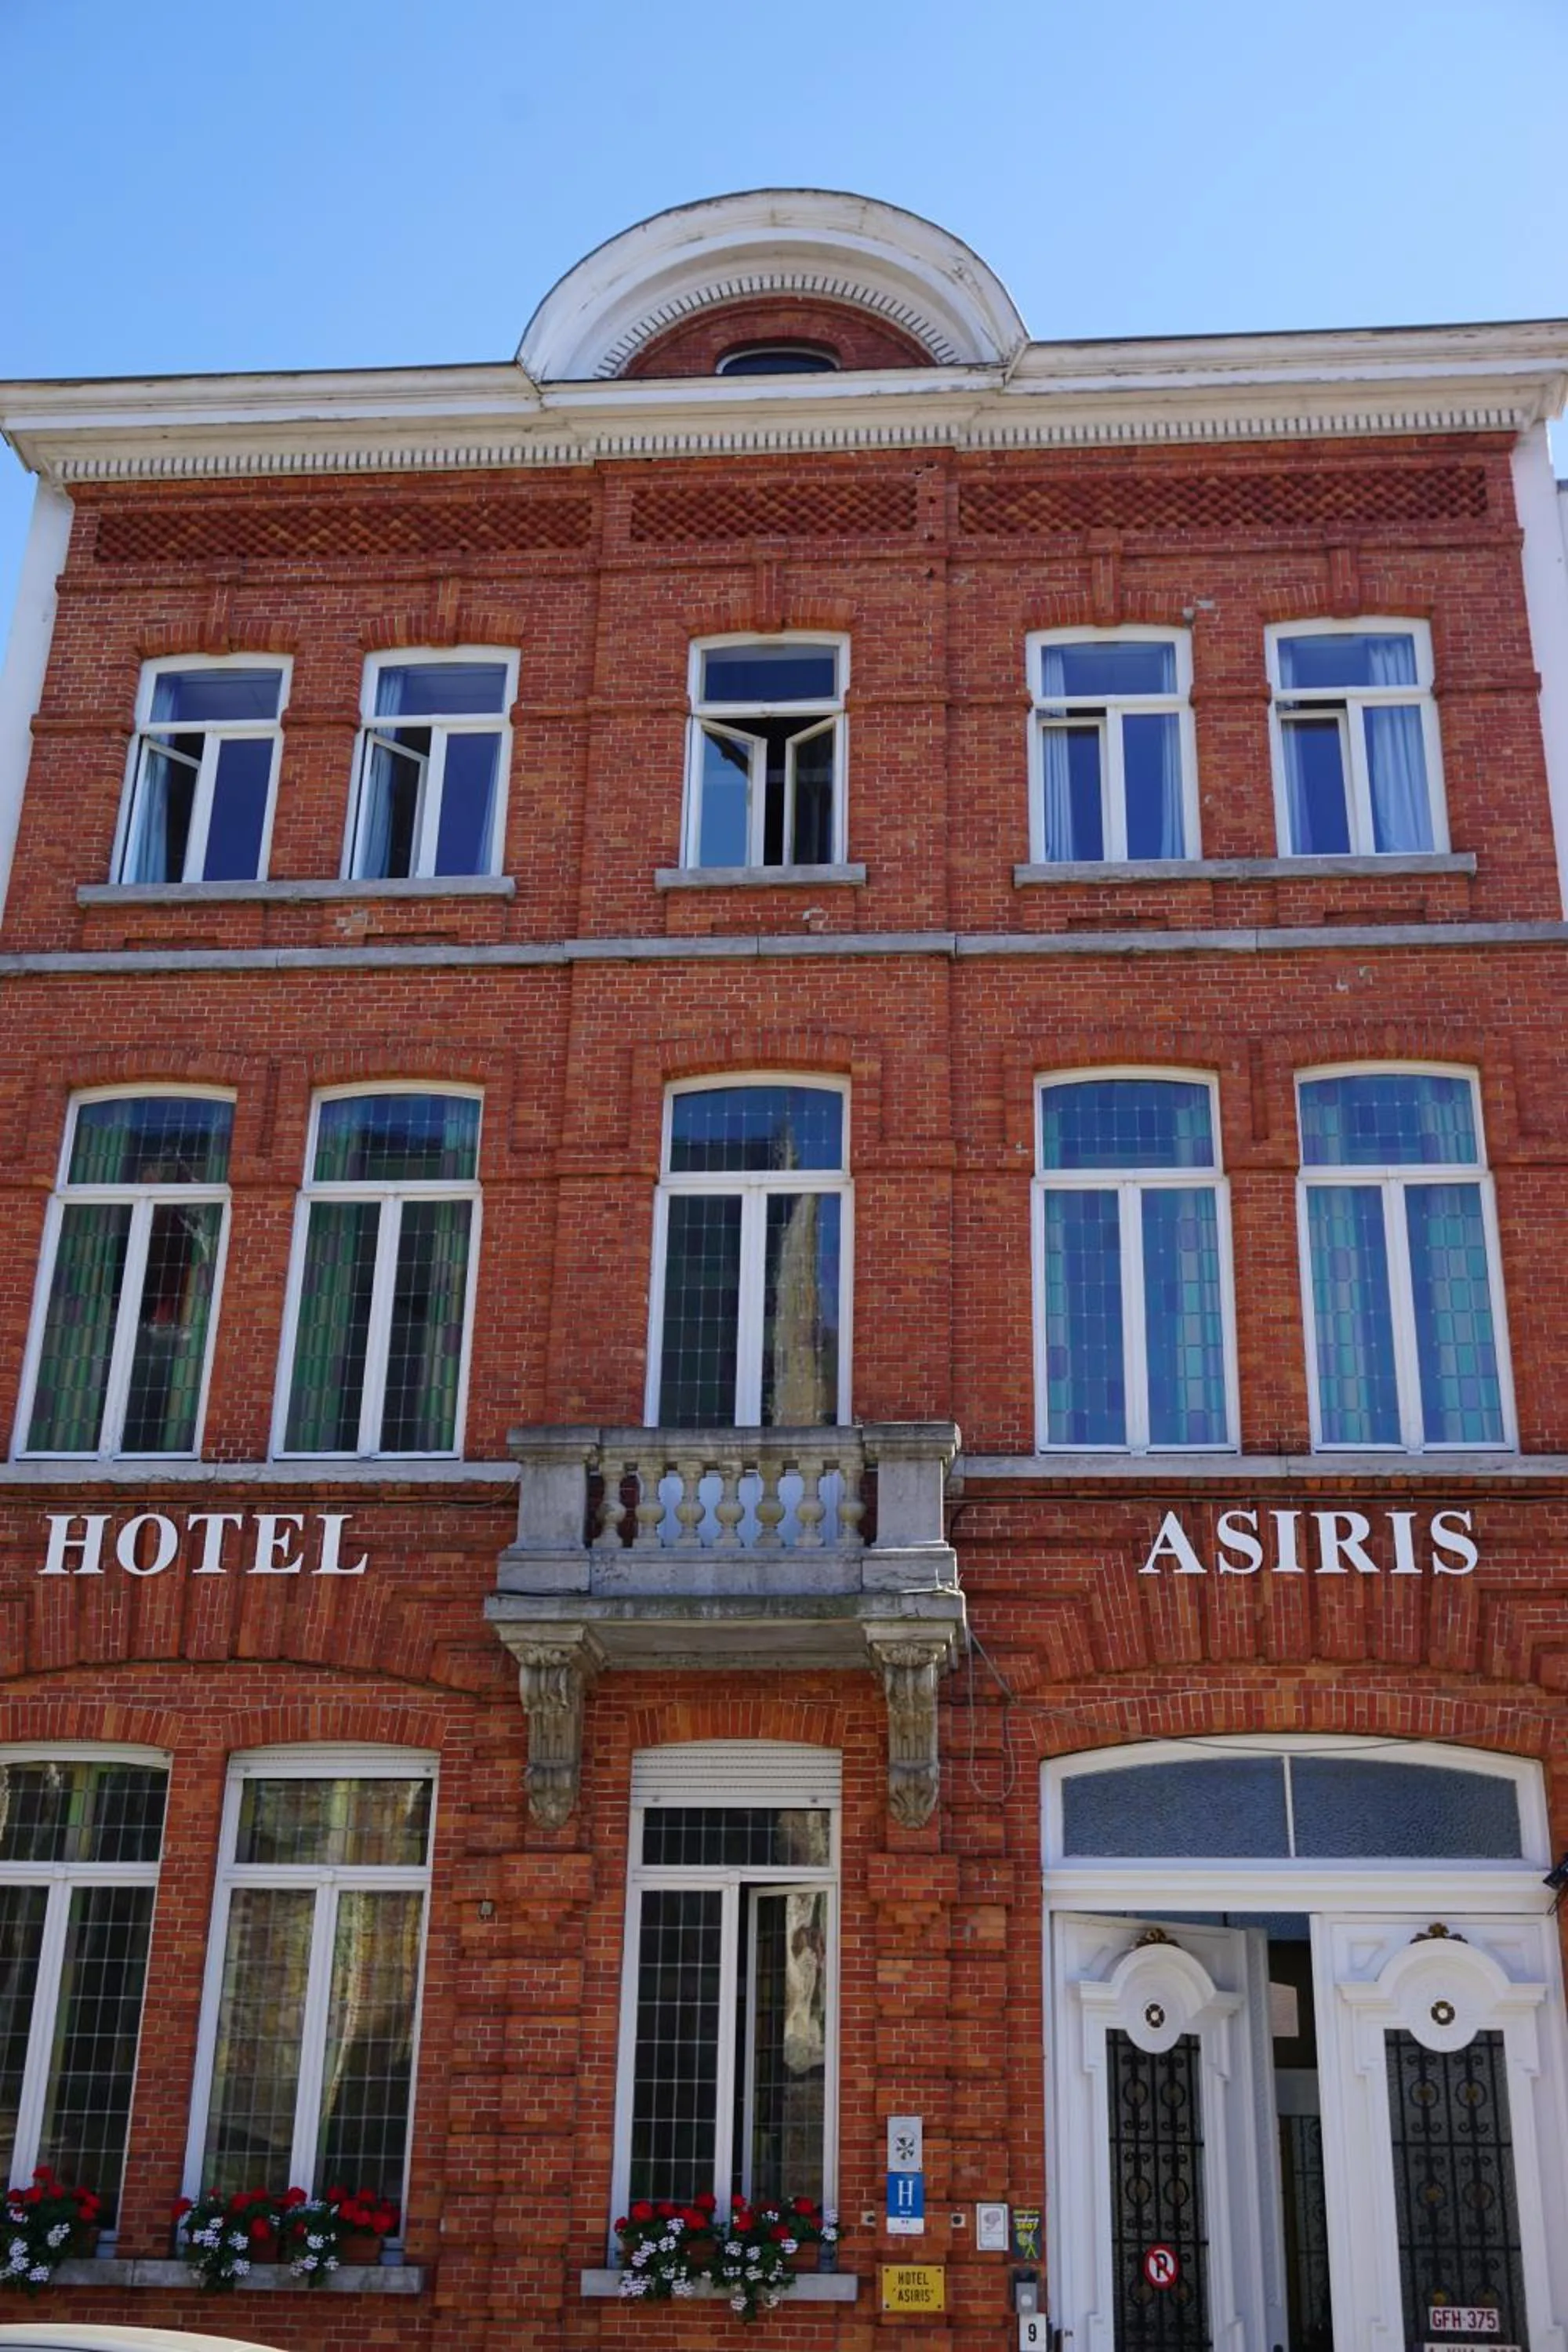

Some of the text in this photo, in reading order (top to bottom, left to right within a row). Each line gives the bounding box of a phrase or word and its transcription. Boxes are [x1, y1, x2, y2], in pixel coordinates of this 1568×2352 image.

[38, 1514, 368, 1575] HOTEL
[1138, 1509, 1479, 1576] ASIRIS
[898, 2180, 913, 2207] H
[898, 2271, 929, 2285] HOTEL
[1028, 2323, 1036, 2342] 9
